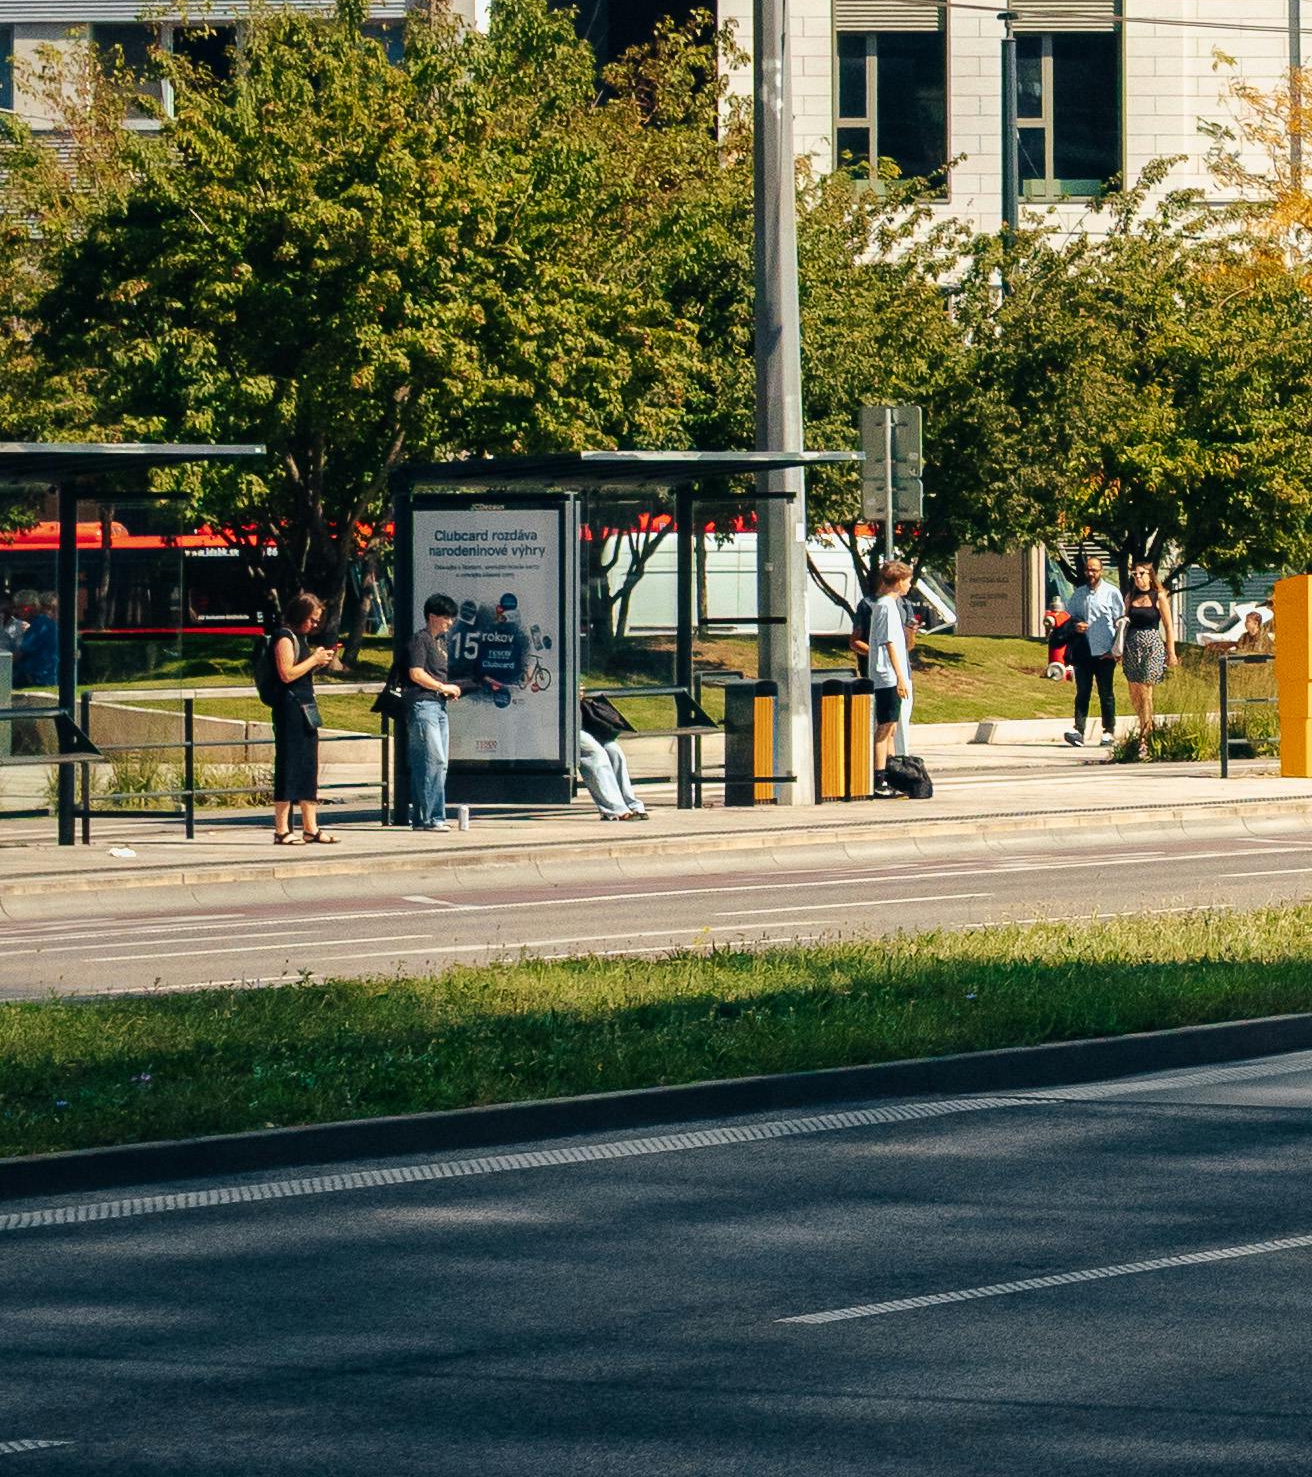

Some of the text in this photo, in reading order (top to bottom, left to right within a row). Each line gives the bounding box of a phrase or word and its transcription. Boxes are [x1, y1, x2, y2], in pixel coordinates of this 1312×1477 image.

[434, 530, 537, 542] Clubcard rozdáva
[429, 543, 545, 558] narodeninové výhry
[451, 631, 514, 659] 15 rokov
[482, 660, 515, 669] Clubcard
